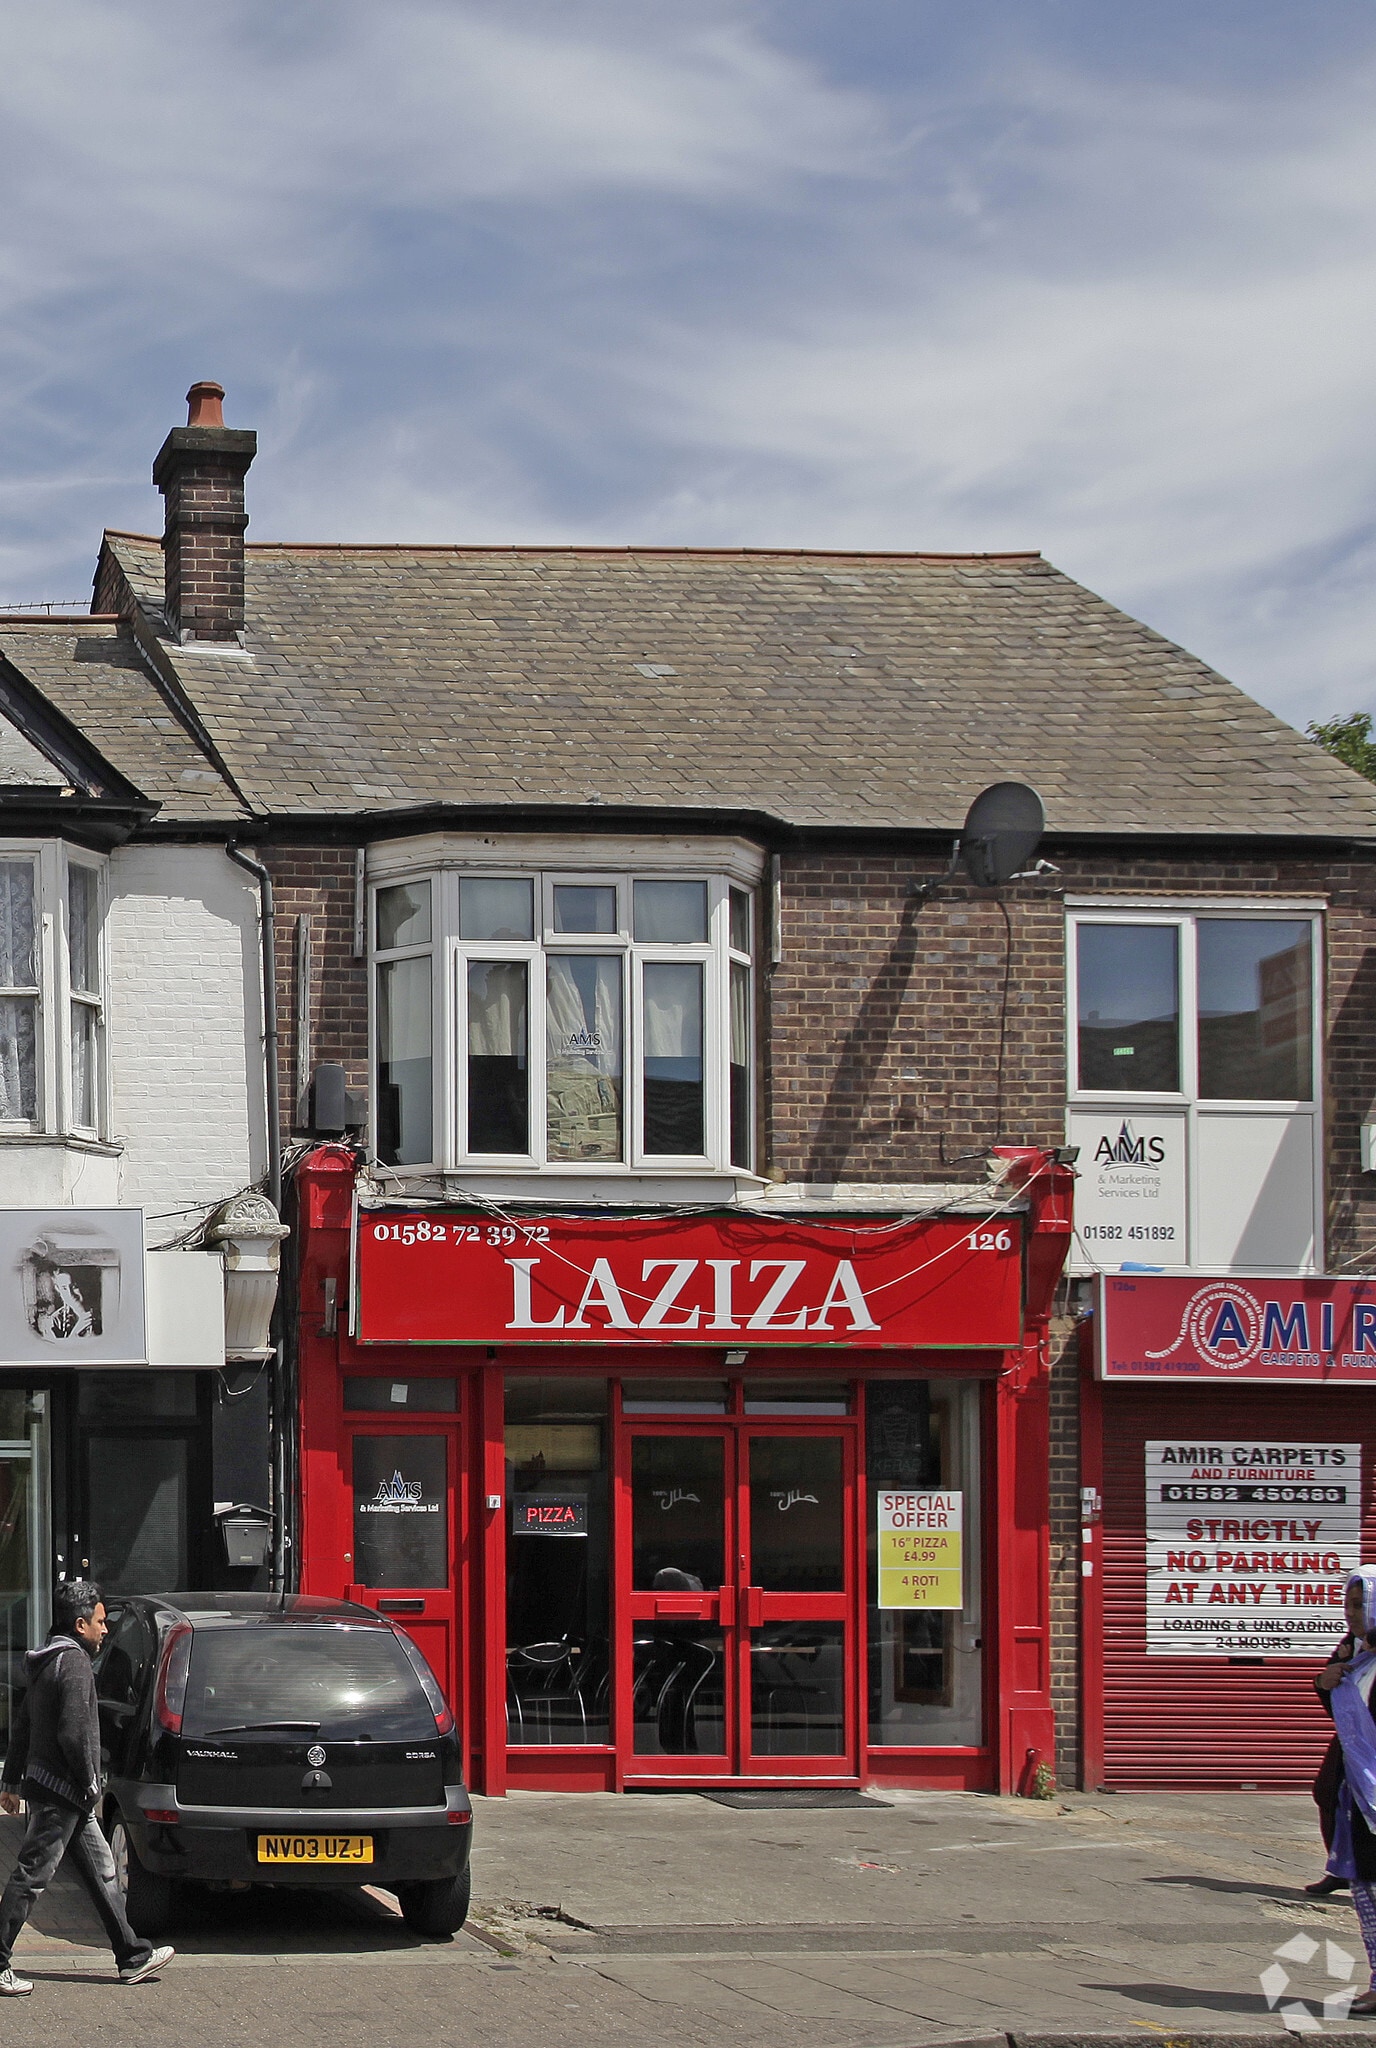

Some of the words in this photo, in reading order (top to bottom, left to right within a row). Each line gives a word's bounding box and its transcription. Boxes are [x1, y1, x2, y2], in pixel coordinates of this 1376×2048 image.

[569, 1033, 601, 1045] AMS
[1093, 1135, 1165, 1163] AMS
[1097, 1175, 1106, 1185] &
[1109, 1174, 1161, 1187] Marketing
[1098, 1187, 1140, 1198] Services
[1143, 1187, 1159, 1198] Ltd
[373, 1220, 447, 1245] 01582
[452, 1225, 481, 1245] 72
[486, 1224, 516, 1246] 39
[522, 1225, 550, 1246] 72
[967, 1229, 1011, 1251] 126
[1083, 1225, 1122, 1239] 01582
[1128, 1226, 1175, 1240] 451892
[504, 1257, 881, 1330] LAZIZA
[1207, 1299, 1376, 1353] AMIR
[1131, 1361, 1162, 1371] 01582
[1260, 1351, 1320, 1367] CARPETS
[1326, 1354, 1337, 1367] &
[1161, 1447, 1223, 1464] AMIR
[1231, 1447, 1346, 1465] CARPETS
[1190, 1468, 1222, 1479] AND
[1228, 1468, 1315, 1481] FURNITURE
[377, 1481, 422, 1499] AMS
[1168, 1486, 1240, 1500] 01582
[1251, 1488, 1340, 1501] 450480
[778, 1489, 819, 1511] حلال
[884, 1495, 956, 1511] SPECIAL
[367, 1504, 400, 1514] Marketing
[400, 1504, 427, 1512] Services
[428, 1504, 439, 1512] Ltd
[526, 1506, 576, 1522] PIZZA
[891, 1512, 948, 1528] OFFER
[1186, 1518, 1323, 1541] STRICTLY
[913, 1537, 948, 1548] PIZZA
[904, 1551, 936, 1561] £4.99
[1166, 1550, 1206, 1573] NO
[1216, 1551, 1342, 1574] PARKING
[901, 1575, 909, 1586] 4
[912, 1575, 939, 1586] ROTI
[913, 1589, 927, 1599] £1
[1164, 1582, 1199, 1604] AT
[1207, 1583, 1267, 1605] ANY
[1275, 1584, 1344, 1605] TIME
[1164, 1619, 1231, 1631] LOADING
[1236, 1620, 1246, 1631] &
[1253, 1620, 1345, 1632] UNLOADING
[1215, 1636, 1232, 1649] 24
[1239, 1637, 1292, 1649] HOURS
[186, 1749, 238, 1759] VAUXHALL
[405, 1751, 436, 1759] CORSA
[266, 1838, 317, 1859] NV03
[325, 1838, 364, 1858] UZJ
